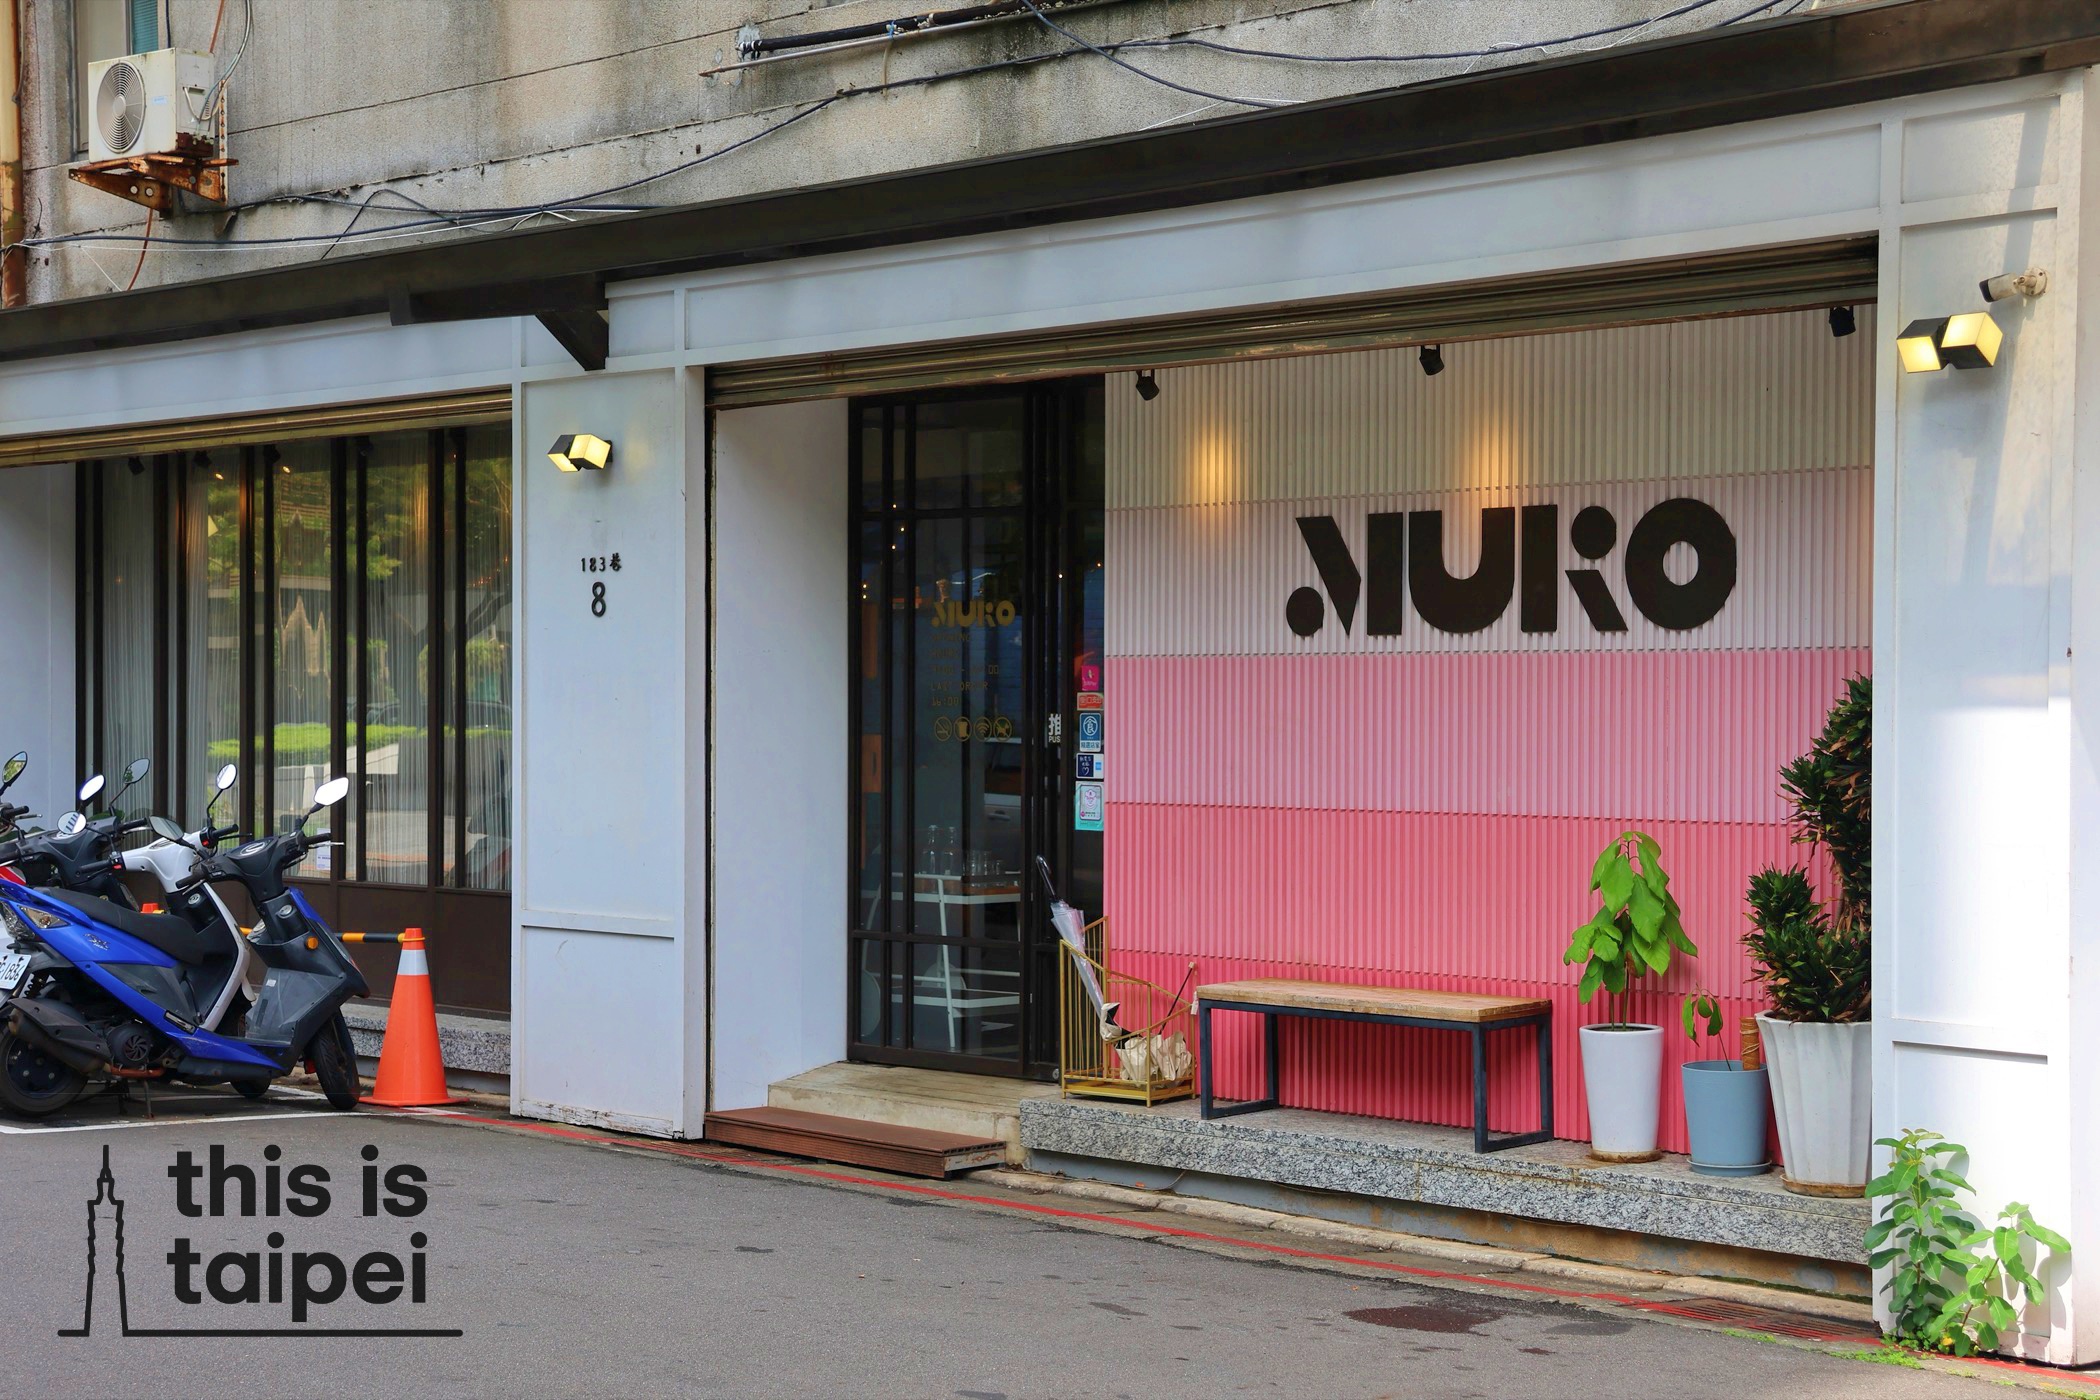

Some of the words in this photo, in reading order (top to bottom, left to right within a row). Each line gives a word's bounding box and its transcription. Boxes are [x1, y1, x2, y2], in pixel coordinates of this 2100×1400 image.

[591, 581, 607, 618] 8
[959, 681, 988, 692] ORR
[1048, 713, 1062, 736] 推
[1048, 735, 1061, 743] PUS
